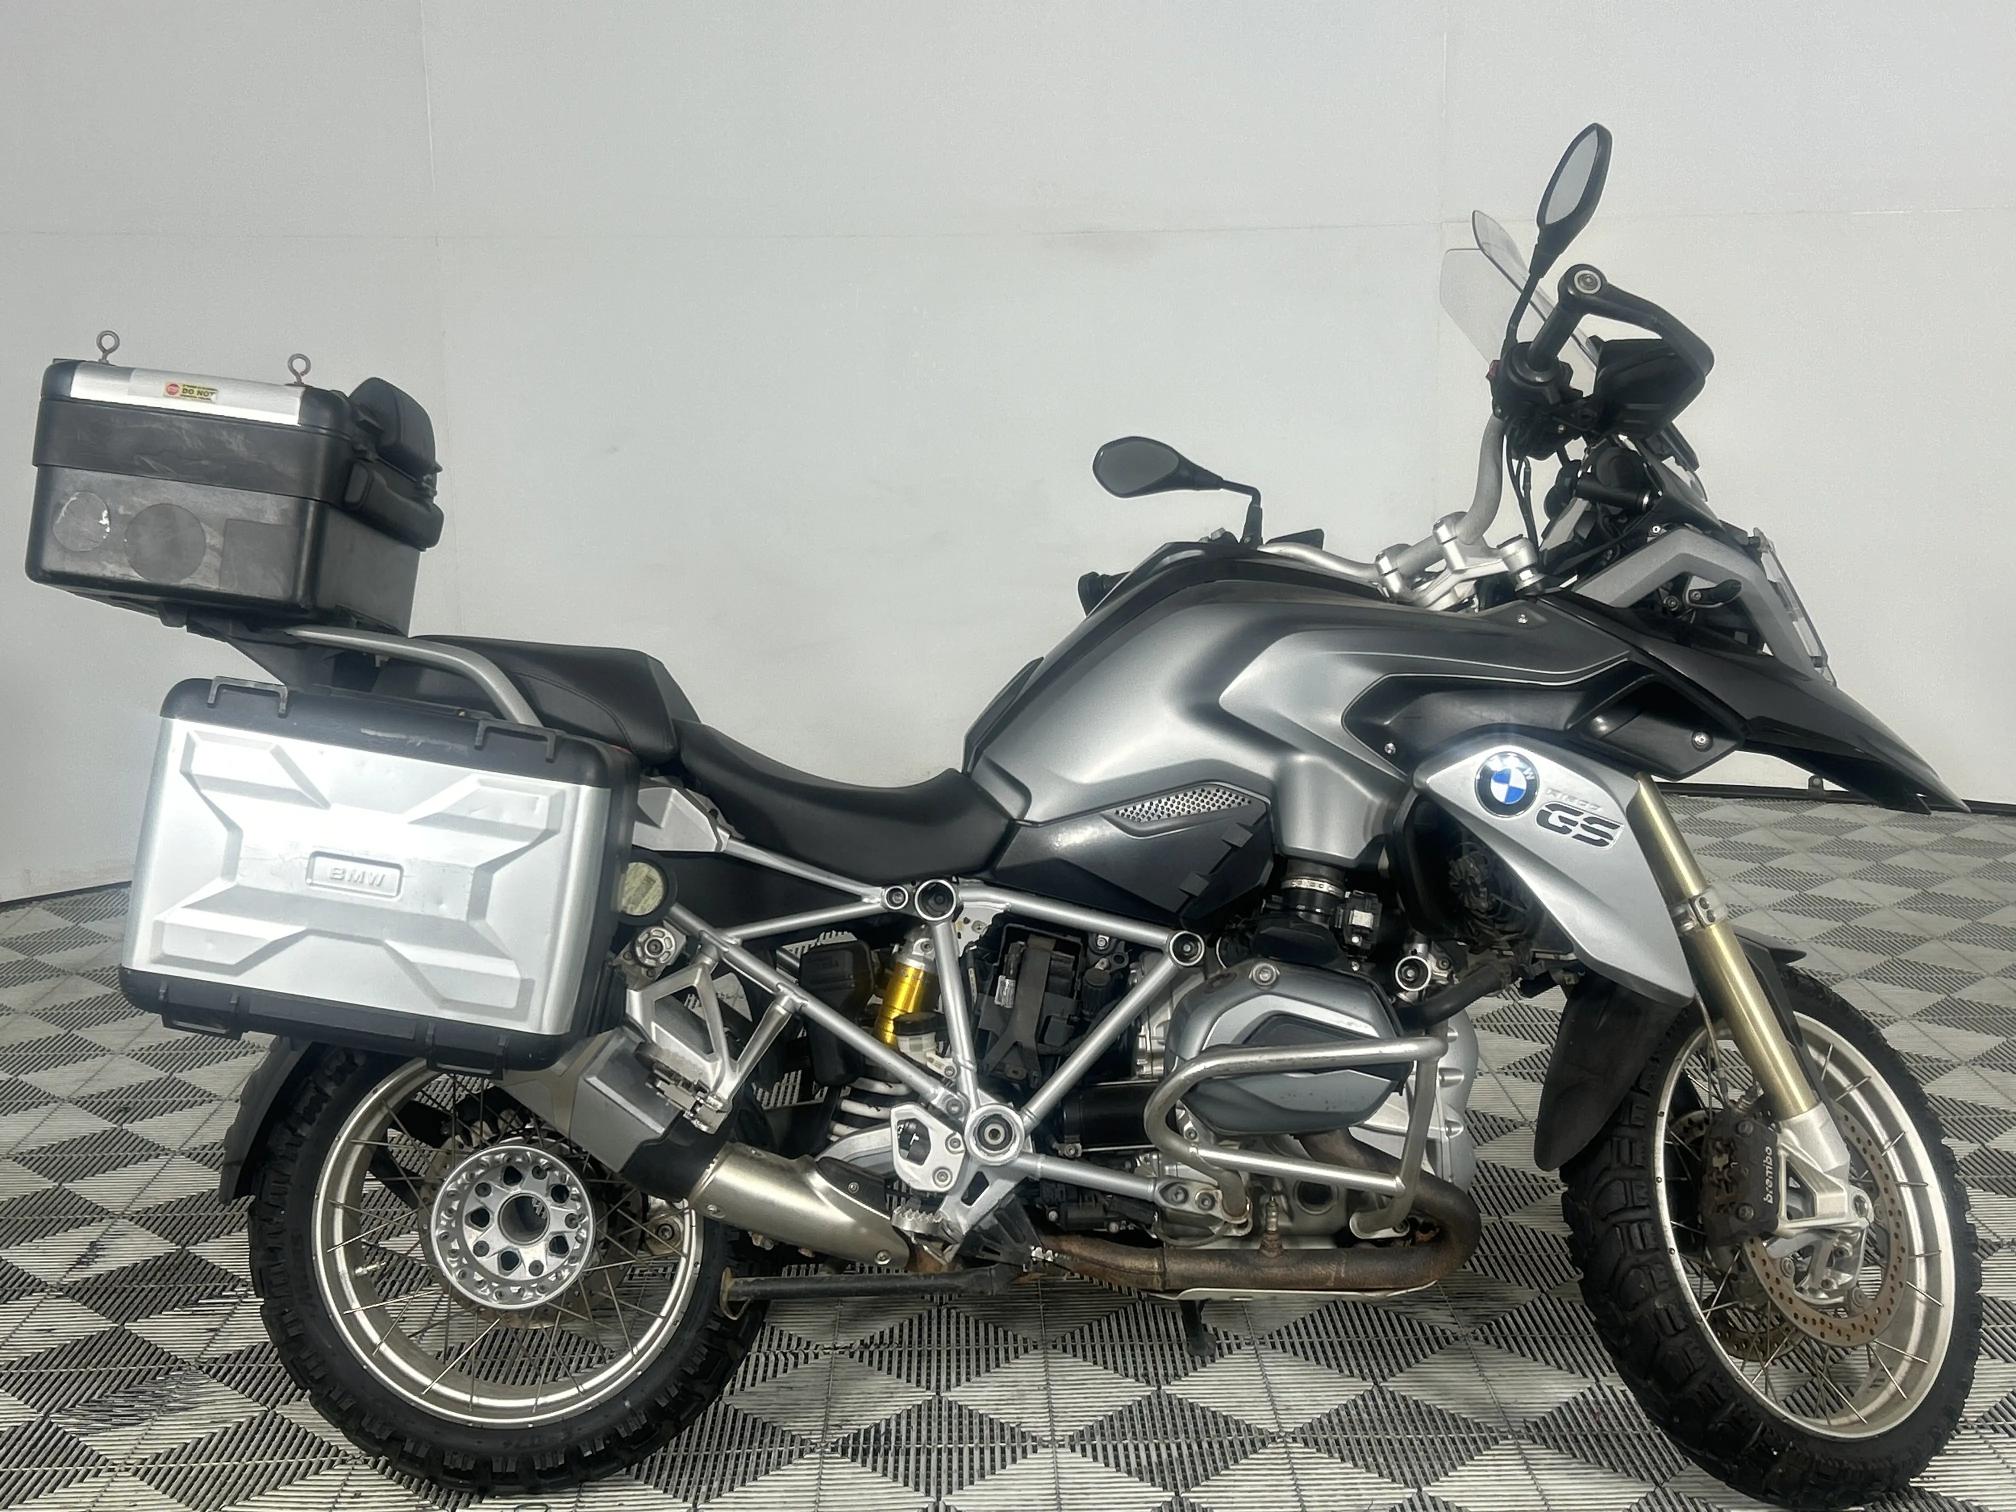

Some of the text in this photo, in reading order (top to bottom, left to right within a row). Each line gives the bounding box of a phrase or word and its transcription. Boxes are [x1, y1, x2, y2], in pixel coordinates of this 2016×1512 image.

[1536, 803, 1621, 848] GS
[329, 867, 387, 887] BMW
[1763, 1146, 1774, 1204] brembo
